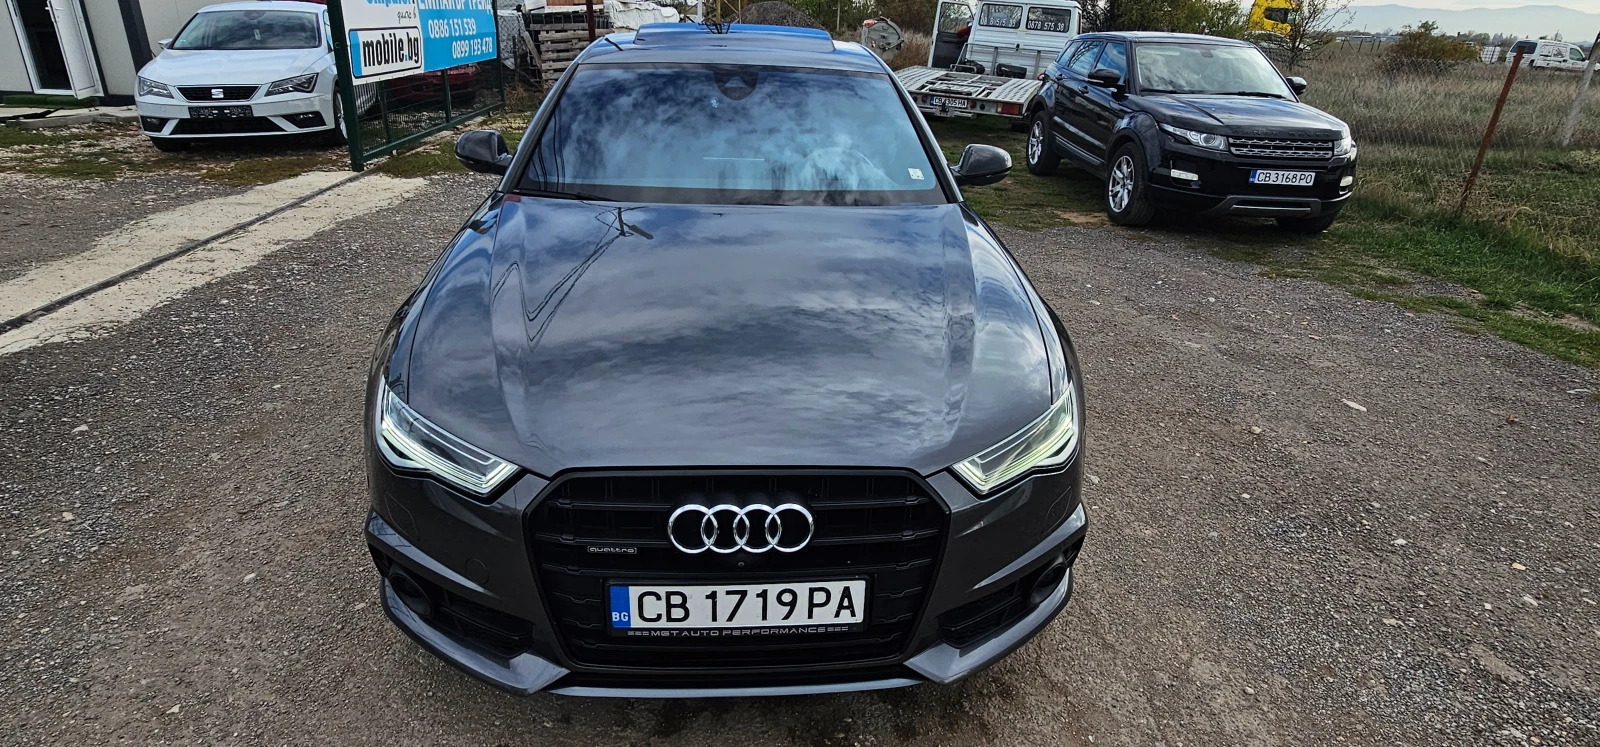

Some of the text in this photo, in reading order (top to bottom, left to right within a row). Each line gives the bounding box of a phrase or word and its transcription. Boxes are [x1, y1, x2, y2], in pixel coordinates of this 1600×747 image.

[428, 18, 477, 39] 0886 151 539
[1027, 20, 1042, 30] 0878
[1044, 21, 1055, 31] 575
[362, 31, 420, 67] mobile.bg
[452, 36, 493, 59] 0899 193 478
[1257, 171, 1272, 183] CB
[1272, 172, 1298, 184] 3168
[637, 586, 857, 623] CB 1719 PA
[611, 611, 629, 622] BG
[722, 627, 826, 637] PERFORMANCE
